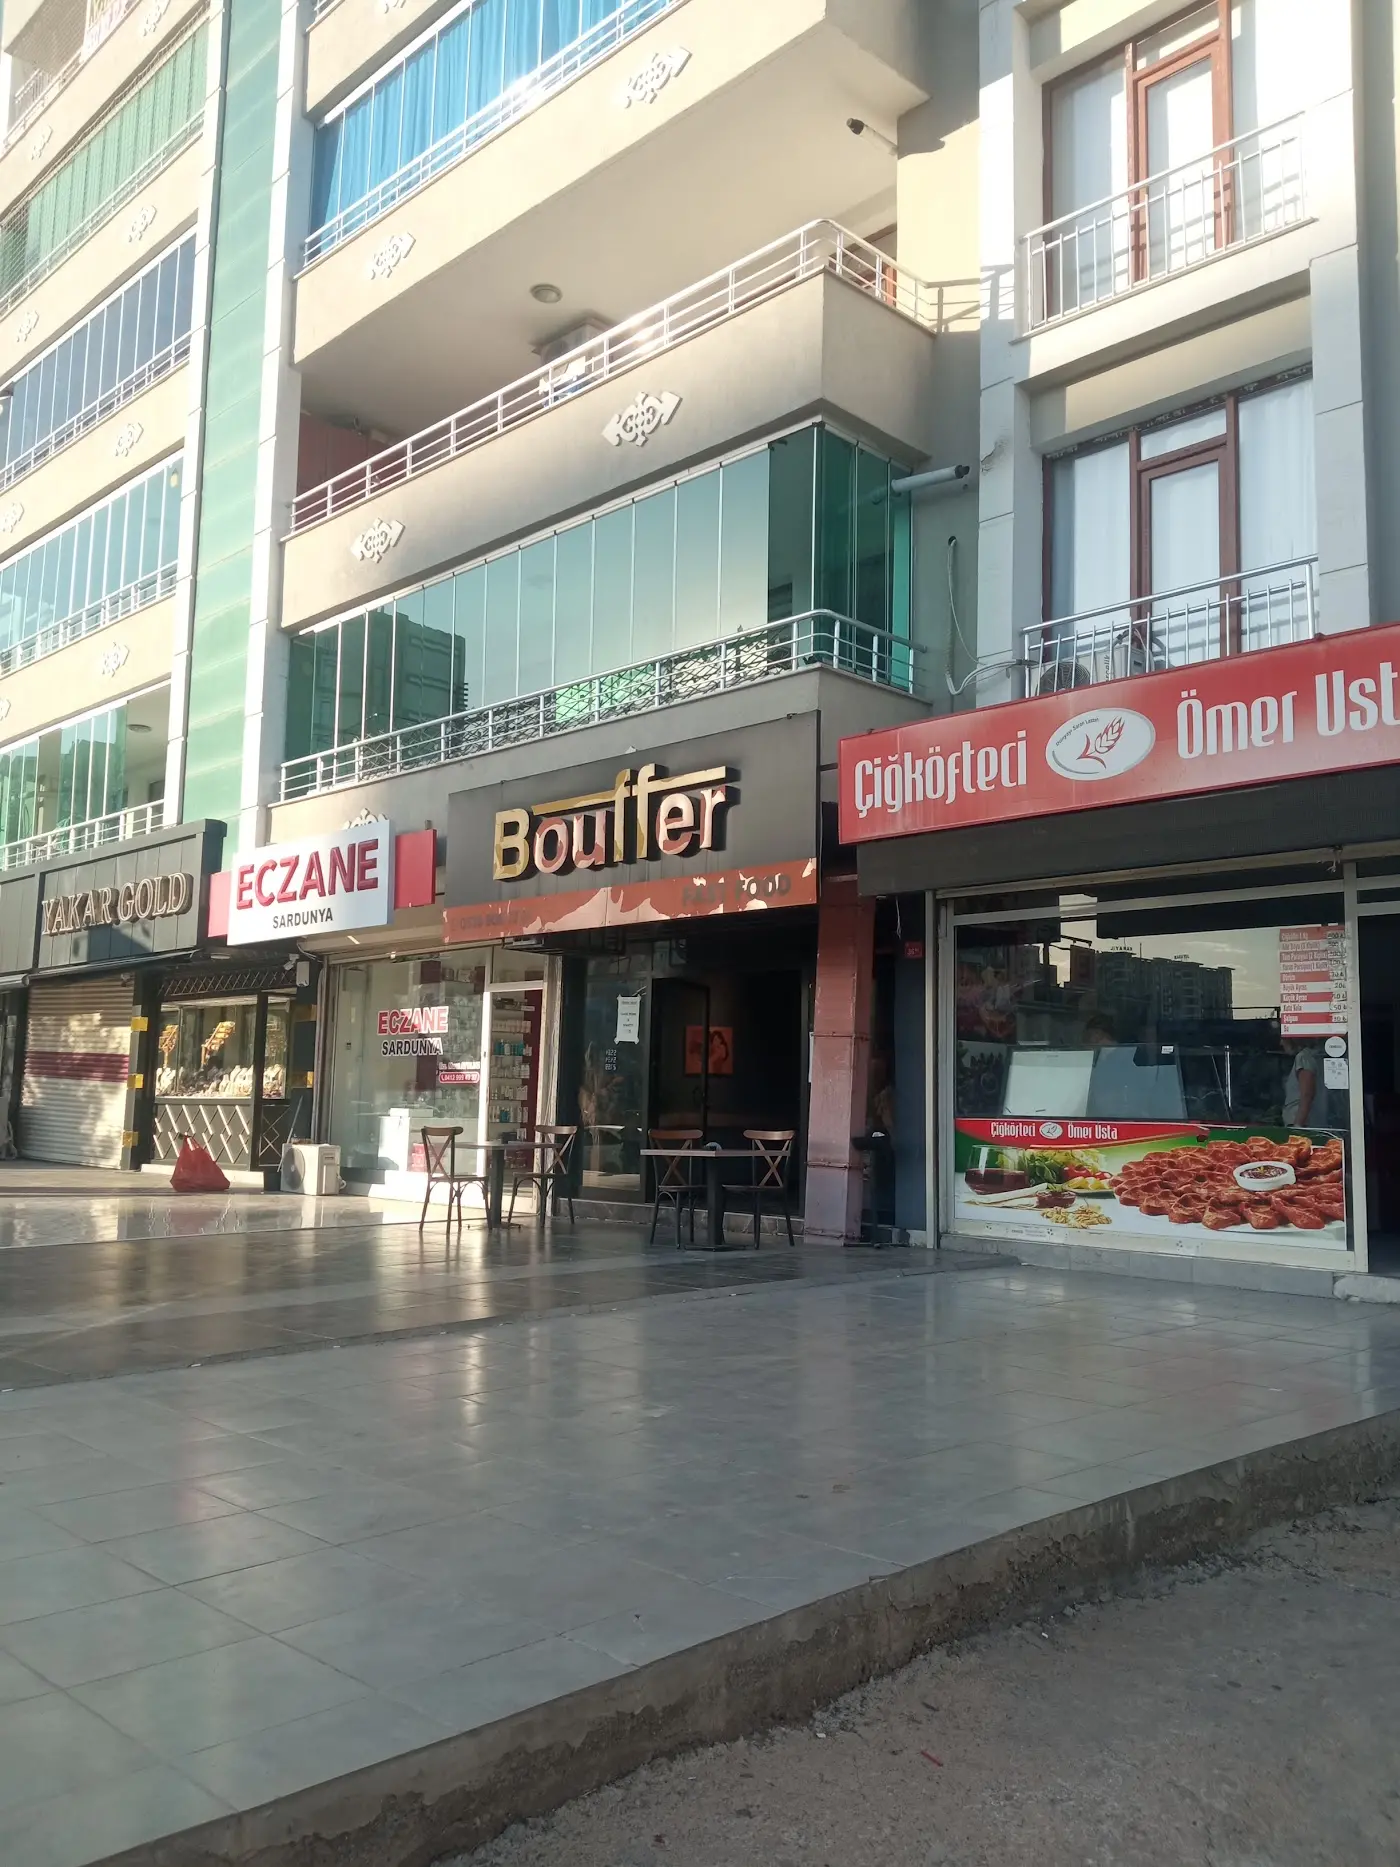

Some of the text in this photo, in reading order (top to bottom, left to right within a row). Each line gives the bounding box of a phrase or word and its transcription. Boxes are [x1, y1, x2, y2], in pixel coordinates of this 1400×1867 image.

[1176, 688, 1298, 760] Ömer
[854, 730, 1027, 819] Çiğköfteci
[493, 762, 728, 881] Bouffer
[236, 838, 379, 911] ECZANE
[735, 874, 792, 902] FOOD
[42, 871, 191, 936] YAKAR GOLD
[272, 907, 334, 929] SARDUNYA
[377, 1006, 449, 1035] ECZANE
[381, 1037, 444, 1057] SARDUNYA
[990, 1121, 1118, 1140] Çiğköfteci Ömer Usta
